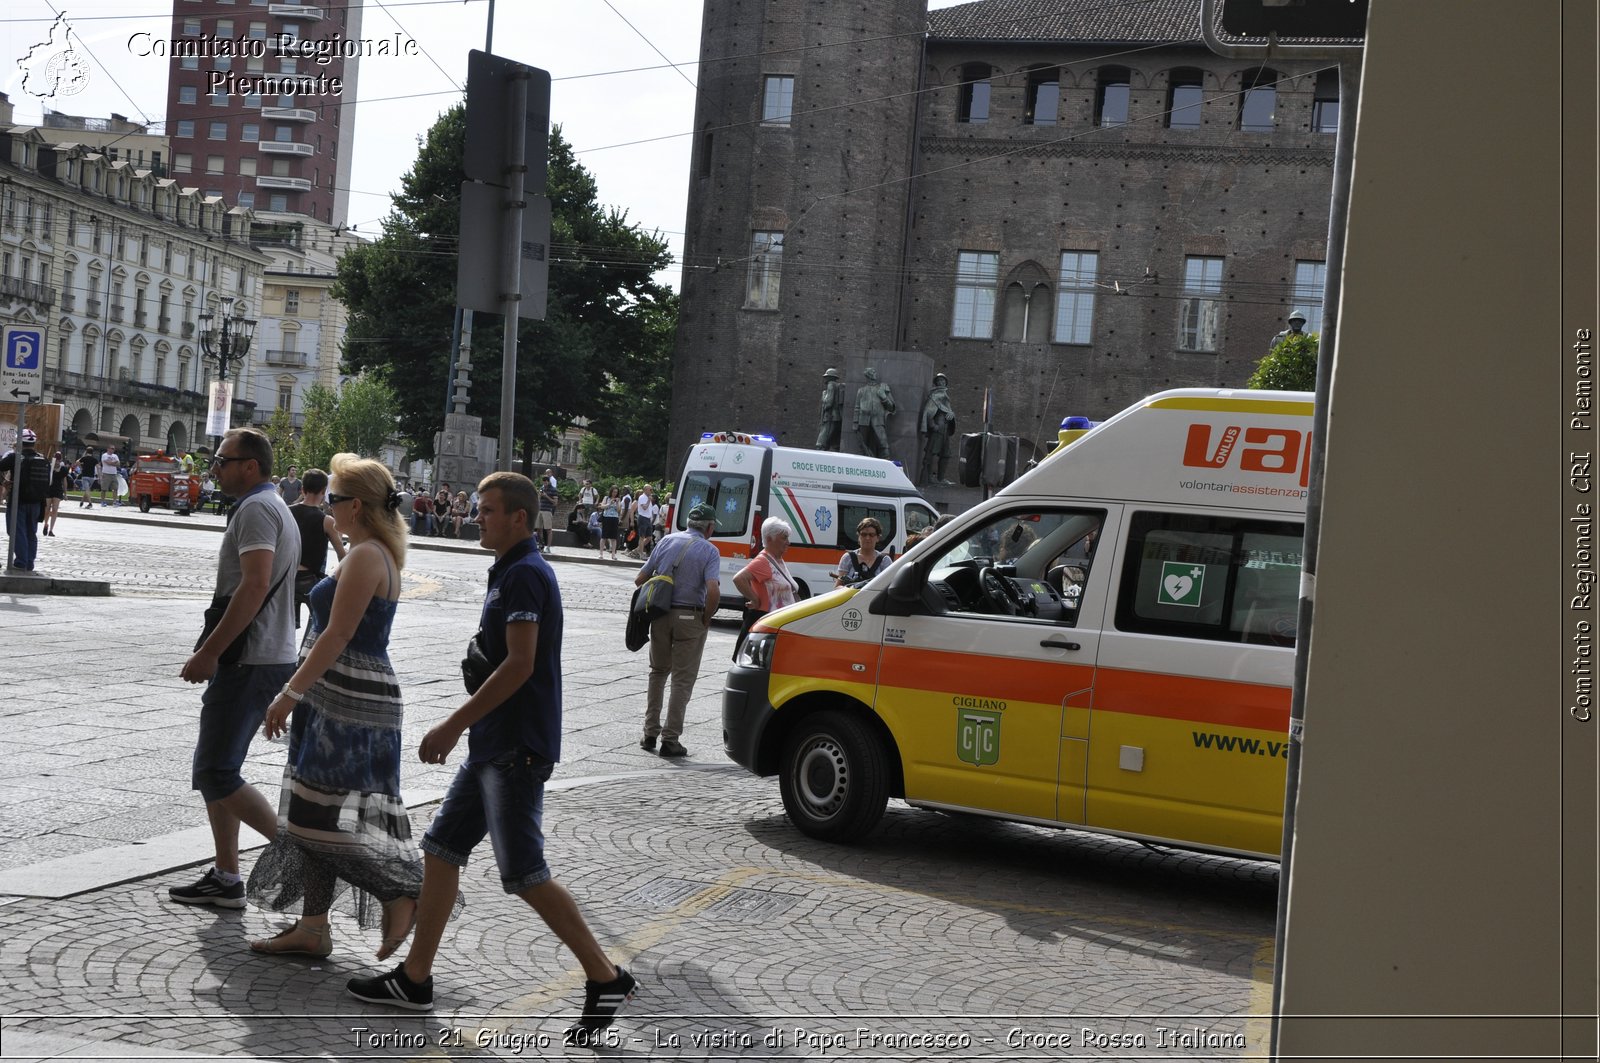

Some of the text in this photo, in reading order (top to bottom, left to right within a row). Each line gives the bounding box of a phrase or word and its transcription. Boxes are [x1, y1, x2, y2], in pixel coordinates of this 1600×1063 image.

[15, 341, 32, 366] P
[1215, 428, 1238, 464] ONLUS
[1183, 424, 1312, 487] va
[791, 461, 887, 479] CROCE VERDE DI BRICHERASIO
[848, 611, 858, 619] 10
[844, 620, 859, 629] 918
[952, 696, 1007, 711] CIGLIANO
